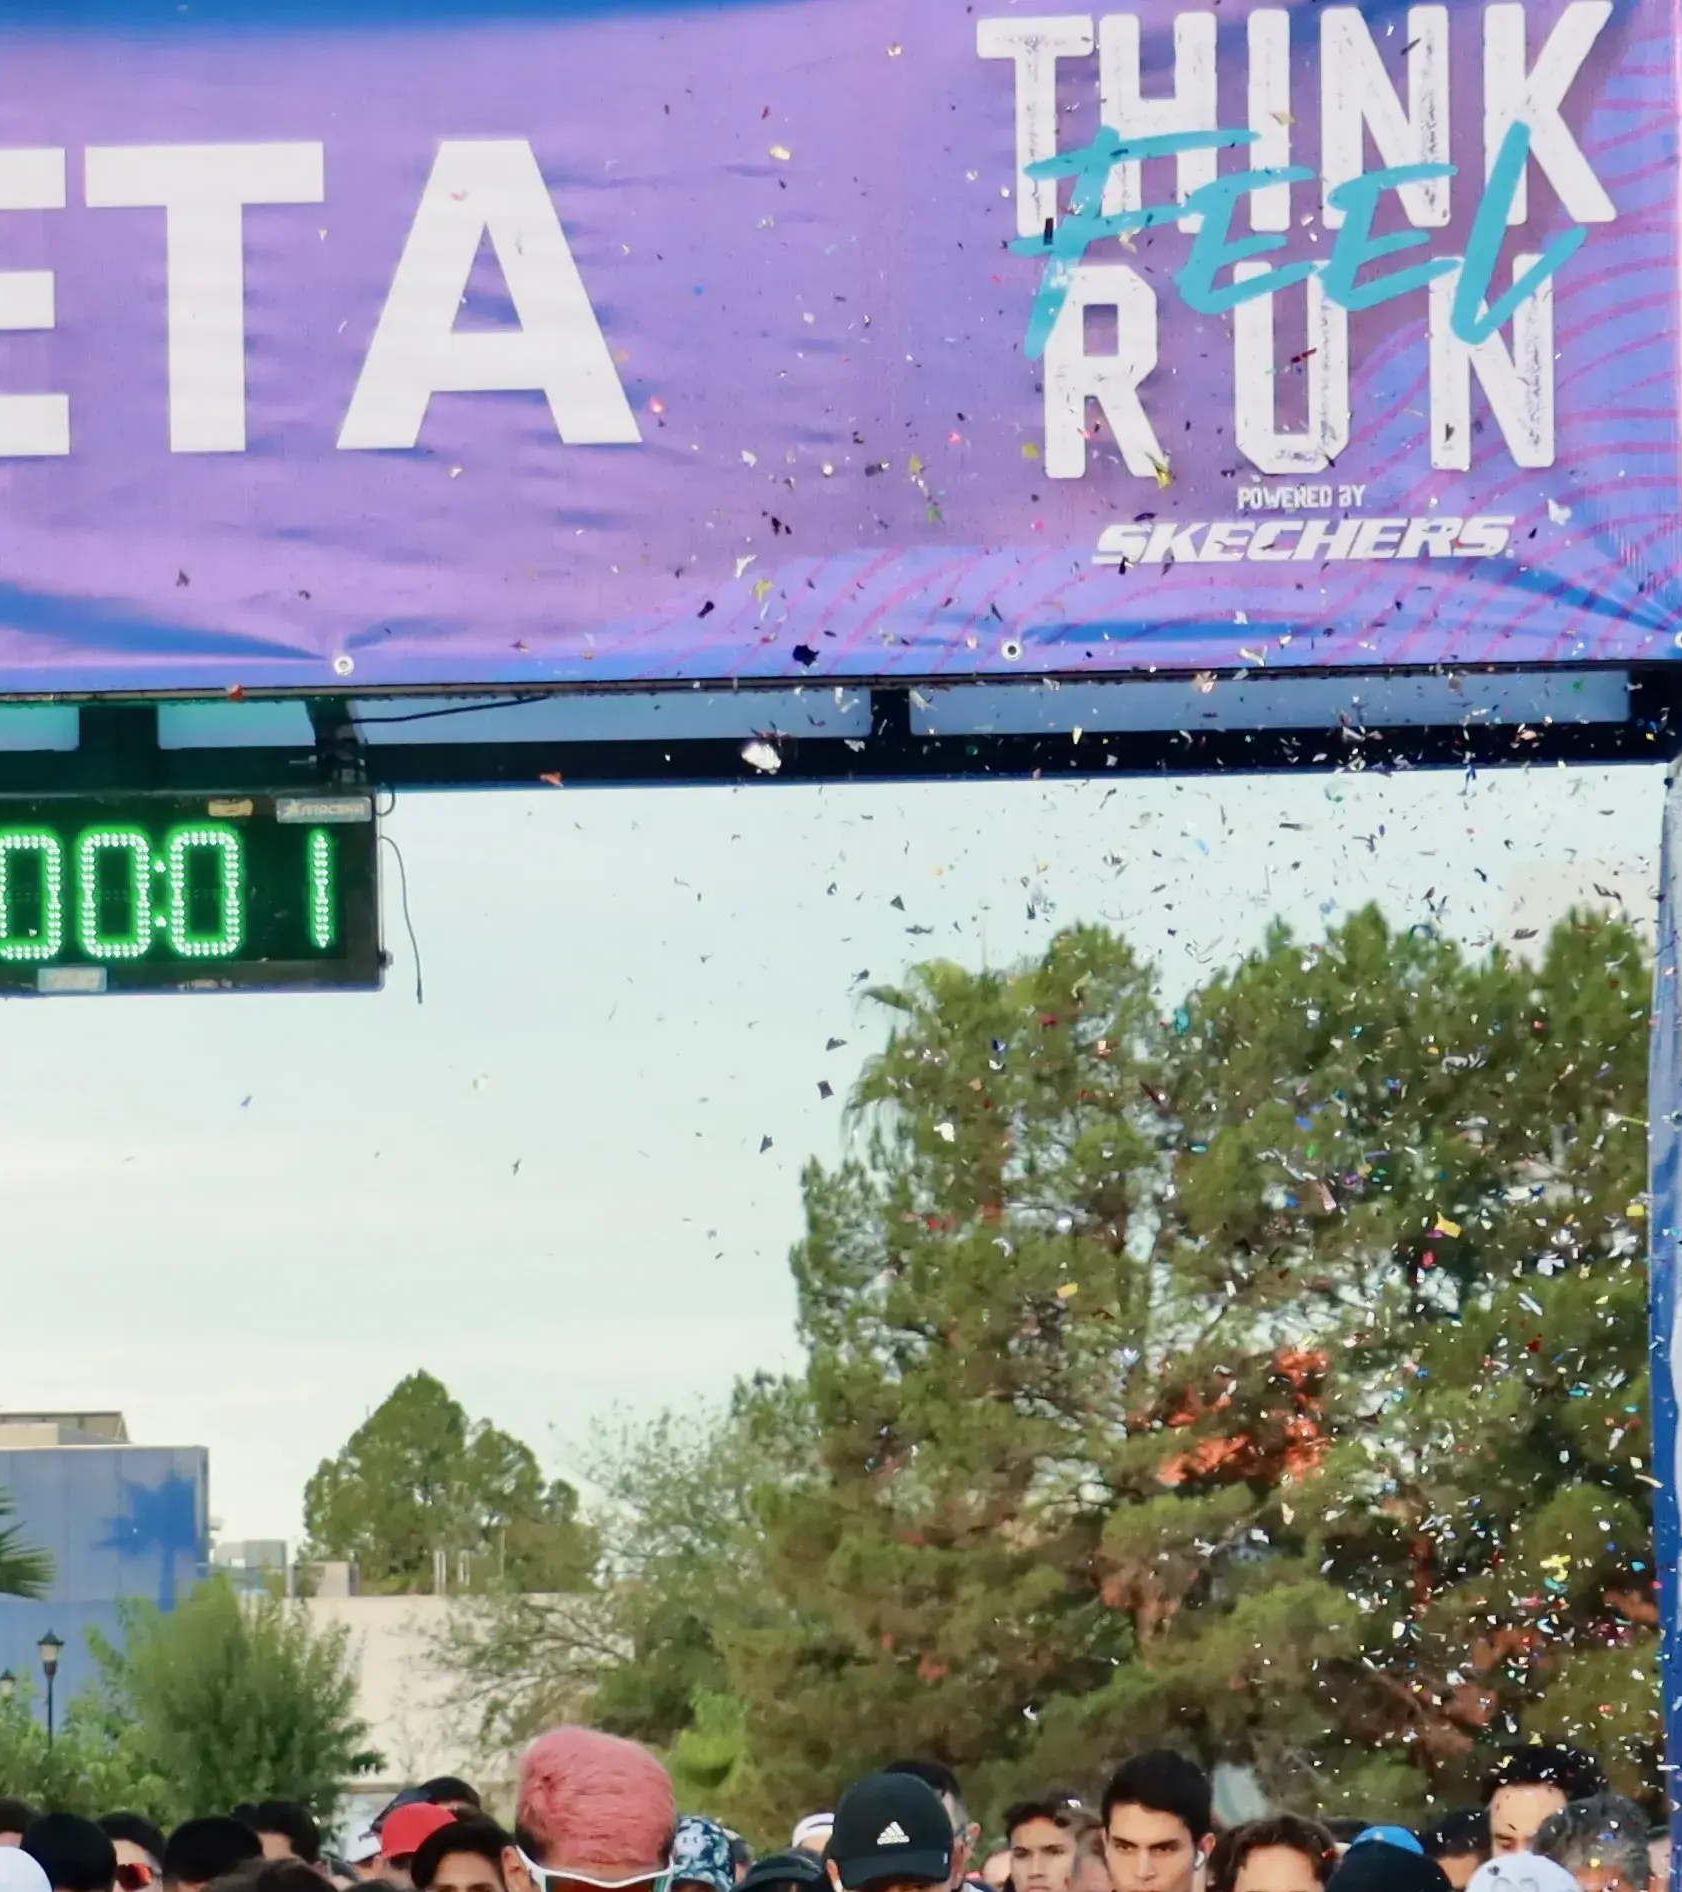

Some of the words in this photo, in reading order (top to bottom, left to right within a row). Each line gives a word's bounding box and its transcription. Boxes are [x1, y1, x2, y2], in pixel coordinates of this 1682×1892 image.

[977, 0, 1618, 237] THINK
[1044, 252, 1557, 480] RUN
[1091, 514, 1516, 566] SKECHERS
[1237, 485, 1333, 511] POWERED
[1338, 484, 1367, 508] BY
